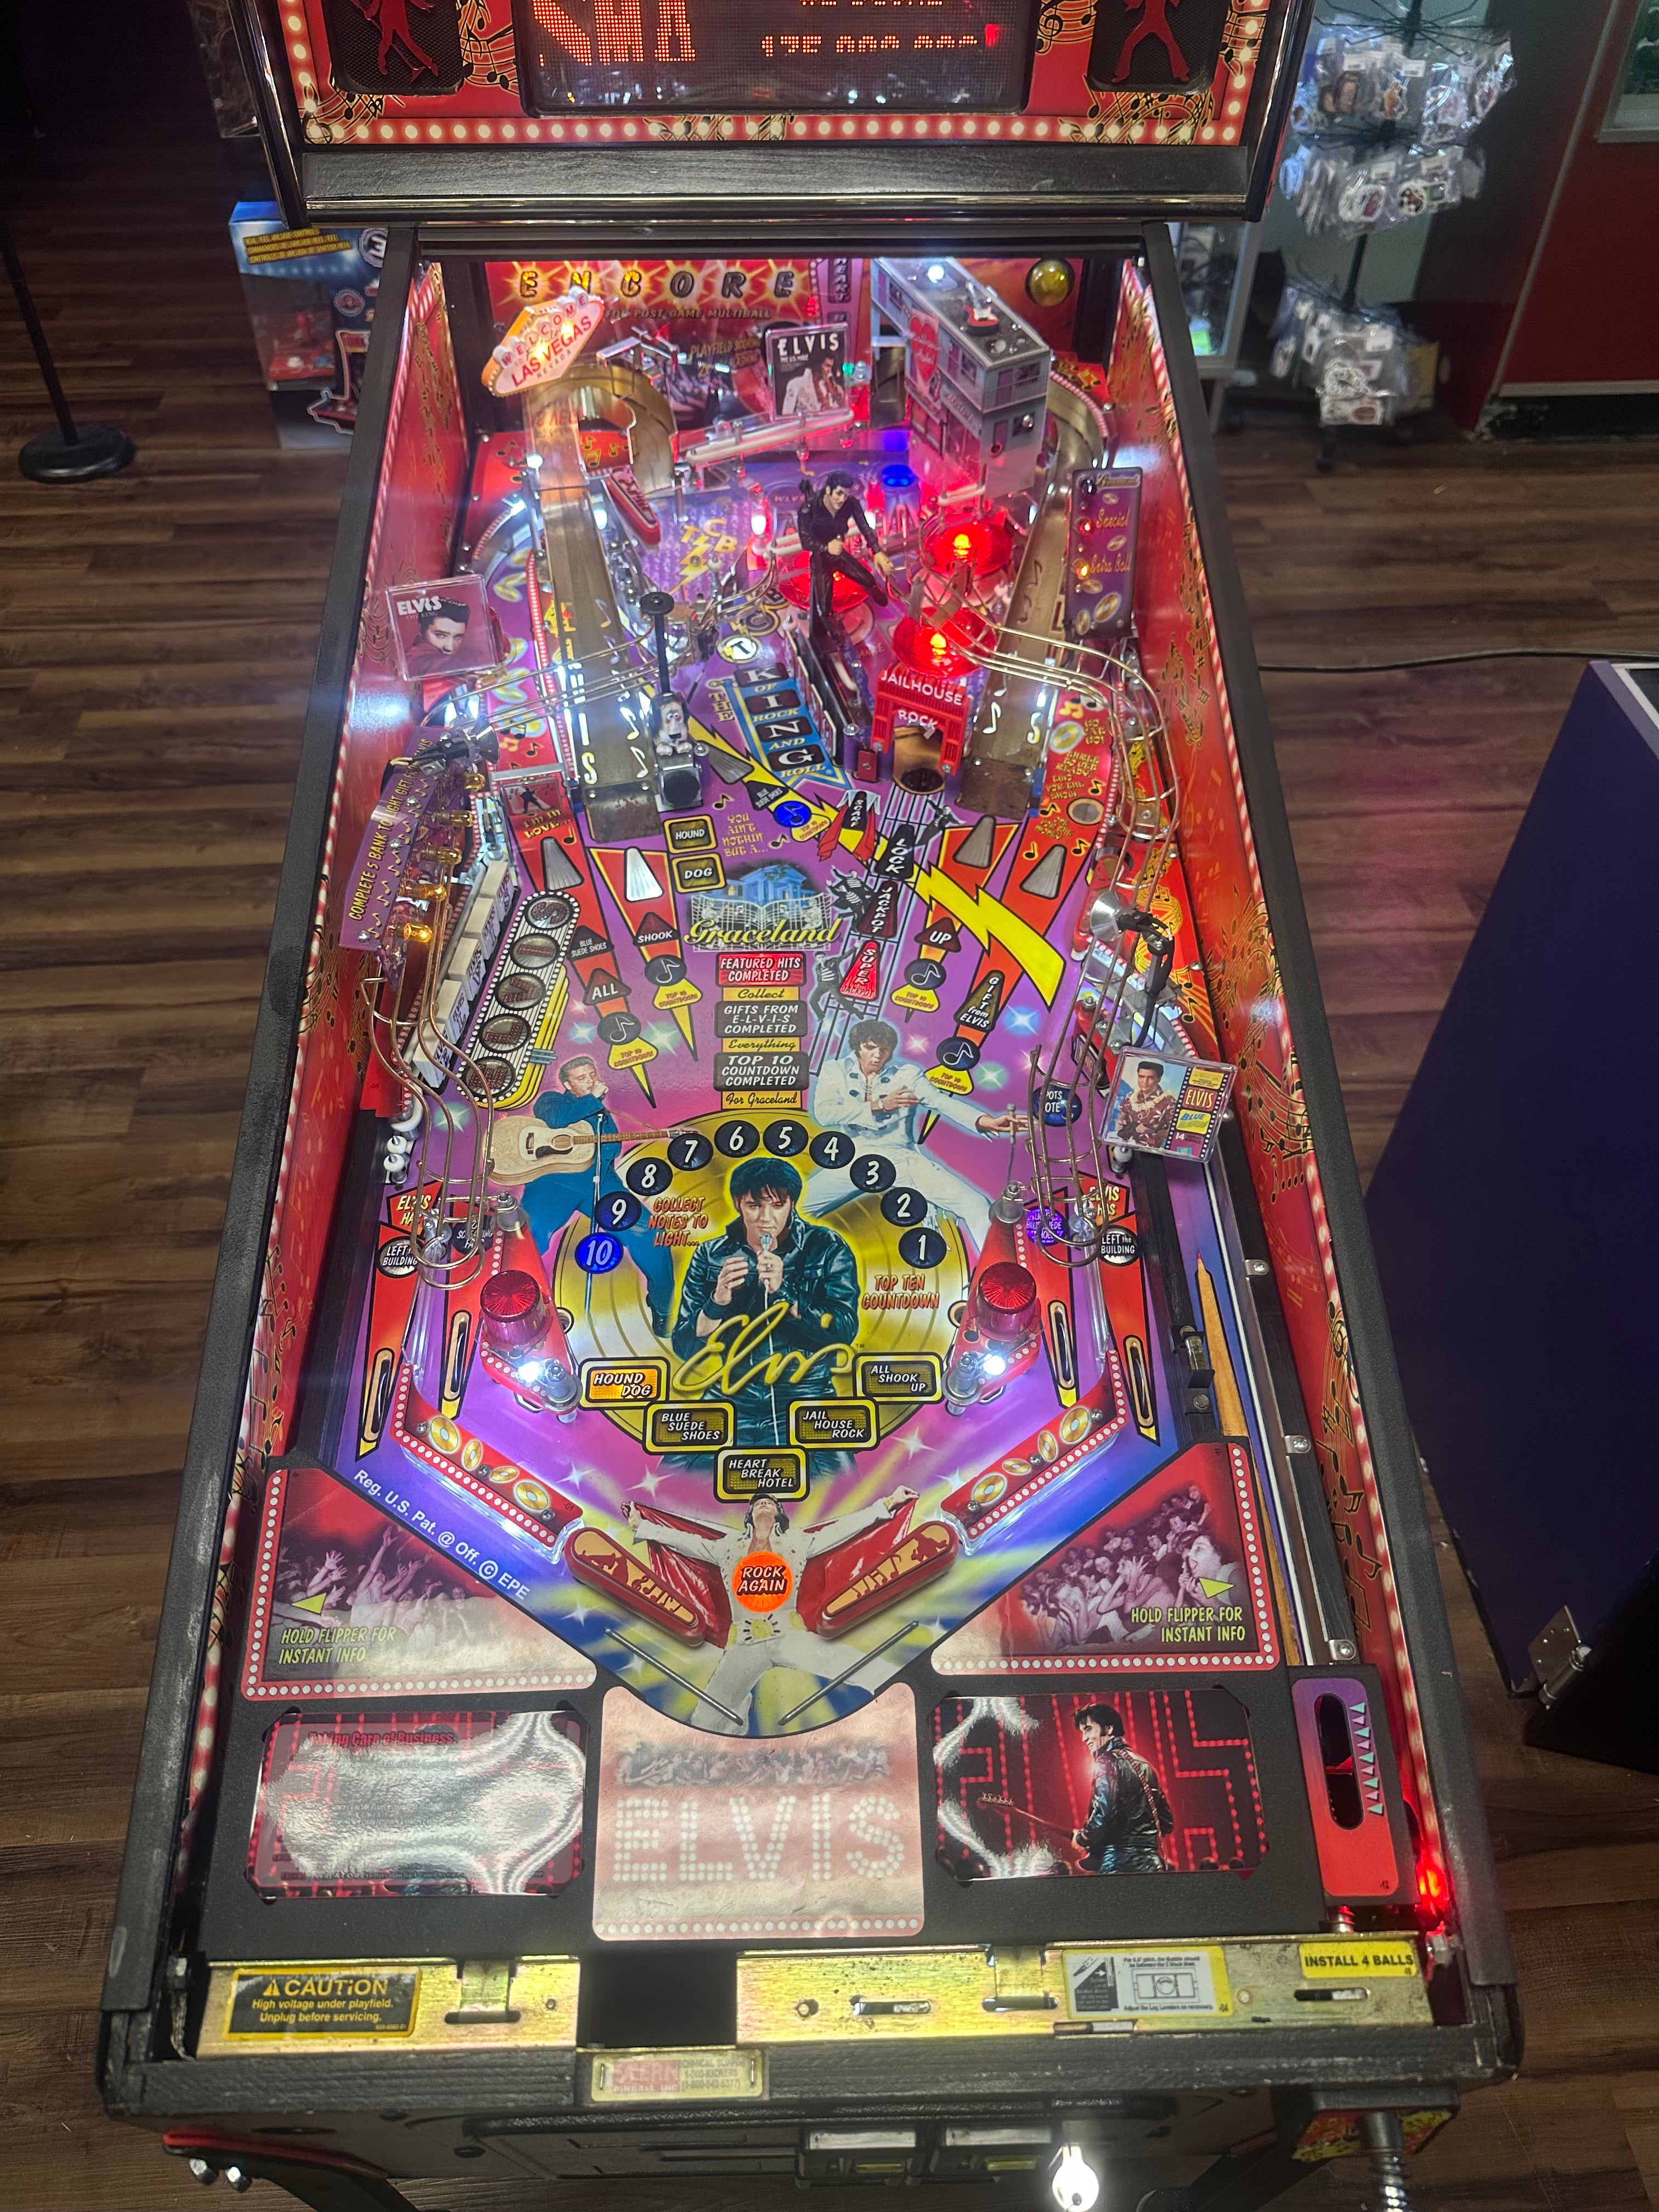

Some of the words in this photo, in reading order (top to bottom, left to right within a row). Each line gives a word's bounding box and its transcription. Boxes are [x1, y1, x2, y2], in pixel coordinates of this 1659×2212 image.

[634, 308, 663, 319] POST
[669, 309, 703, 319] GAME
[707, 309, 771, 319] MULTIBALL
[511, 361, 541, 387] LAS
[543, 315, 591, 363] VEGAS
[777, 332, 839, 357] ELVIS
[537, 351, 572, 379] NEVADA
[1113, 551, 1132, 573] Ball
[397, 595, 443, 617] ELVIS
[755, 684, 776, 693] OF
[880, 672, 962, 706] JAILHOUSE
[708, 692, 735, 722] THE
[753, 708, 800, 722] ROCK
[898, 710, 938, 730] ROCK
[769, 738, 805, 751] AND
[781, 763, 826, 778] ROLL
[397, 774, 414, 797] GIFT
[385, 792, 403, 821] LIGHT
[849, 799, 865, 828] SCARF
[727, 813, 750, 823] YOU
[377, 817, 394, 836] TO
[675, 828, 706, 839] HOUND
[368, 833, 388, 861] BANK
[722, 832, 764, 847] NOTHIN
[724, 846, 747, 857] BUT
[885, 837, 907, 874] LOCK
[370, 861, 379, 872] 5
[684, 868, 713, 880] DOG
[348, 870, 376, 922] COMPLETE
[870, 886, 894, 934] JACKPOT
[637, 929, 673, 944] SHOOK
[684, 918, 842, 946] Graceland
[929, 930, 952, 945] UP
[571, 947, 589, 957] SUEDE
[589, 942, 607, 953] SHOES
[580, 938, 593, 948] BLUE
[720, 957, 774, 970] FEATURED
[777, 957, 801, 969] HITS
[854, 947, 877, 986] SUPER
[727, 969, 789, 983] COMPLETED
[591, 983, 618, 1001] ALL
[665, 991, 678, 1000] TOP
[737, 989, 785, 999] Collect
[841, 986, 874, 997] JACKPOT
[905, 991, 918, 1000] TOP
[981, 977, 999, 1010] GIFT
[658, 993, 698, 1008] COUNTDOWN
[894, 994, 935, 1010] COUNTDOWN
[724, 1005, 758, 1015] GIFTS
[763, 1005, 799, 1014] FROM
[967, 1006, 989, 1018] from
[732, 1014, 791, 1024] E-L-V-I-S
[959, 1013, 990, 1029] ELVIS
[724, 1024, 797, 1034] COMPLETED
[728, 1039, 797, 1051] Everything
[613, 1050, 654, 1068] COUNTDOWN
[620, 1051, 634, 1059] TOP
[727, 1055, 764, 1065] TOP
[772, 1055, 794, 1065] 10
[721, 1065, 800, 1076] COUNTDOWN
[940, 1071, 953, 1081] TOP
[725, 1076, 797, 1087] COMPLETED
[929, 1076, 968, 1093] COUNTDOWN
[726, 1092, 745, 1105] For
[748, 1092, 798, 1108] Graceland
[1185, 1088, 1215, 1109] ELVIS
[1180, 1112, 1205, 1121] BLUE
[729, 1126, 744, 1150] 6
[778, 1126, 792, 1149] 5
[1175, 1132, 1185, 1141] 14
[685, 1139, 698, 1163] 7
[823, 1136, 839, 1161] 4
[641, 1164, 657, 1188] 8
[866, 1160, 879, 1185] 3
[612, 1199, 627, 1224] 9
[653, 1196, 706, 1212] COLLECT
[896, 1193, 911, 1217] 2
[647, 1214, 691, 1229] NOTES
[693, 1214, 709, 1229] TO
[653, 1230, 699, 1246] LIGHT...
[1102, 1234, 1120, 1244] LEFT
[1122, 1234, 1132, 1243] the
[386, 1245, 408, 1256] LEFT
[586, 1240, 613, 1265] 10
[918, 1234, 926, 1260] 1
[1101, 1245, 1135, 1254] BUILDING
[382, 1256, 417, 1266] BUILDING
[874, 1274, 898, 1291] TOP
[902, 1274, 926, 1290] TEN
[861, 1292, 940, 1310] COUNTDOWN
[673, 1301, 856, 1395] Elvis
[871, 1365, 890, 1374] ALL
[593, 1373, 645, 1386] HOUND
[878, 1373, 918, 1383] SHOOK
[621, 1384, 651, 1397] DOG
[911, 1383, 926, 1392] UP
[661, 1412, 691, 1423] BLUE
[803, 1410, 827, 1421] JAIL
[667, 1421, 705, 1432] SUEDE
[814, 1420, 853, 1430] HOUSE
[681, 1430, 720, 1441] SHOES
[832, 1429, 865, 1438] ROCK
[729, 1458, 768, 1469] HEART
[741, 1468, 781, 1479] BREAK
[757, 1477, 794, 1488] HOTEL
[354, 1469, 381, 1497] Reg.
[384, 1489, 409, 1517] U.S.
[411, 1511, 435, 1536] Pat.
[455, 1542, 478, 1565] Off.
[497, 1572, 531, 1601] EPE
[742, 1566, 786, 1579] ROCK
[737, 1579, 787, 1594] AGAIN
[1131, 1607, 1162, 1623] HOLD
[1166, 1606, 1215, 1623] FLIPPER
[1218, 1606, 1243, 1622] FOR
[281, 1628, 316, 1644] HOLD
[318, 1626, 367, 1644] FLIPPER
[371, 1626, 396, 1642] FOR
[1161, 1626, 1212, 1643] INSTANT
[1216, 1625, 1246, 1641] INFO
[278, 1647, 334, 1664] INSTANT
[336, 1646, 366, 1663] INFO
[351, 1731, 380, 1746] Care
[383, 1732, 396, 1745] of
[397, 1732, 454, 1745] Business
[612, 1793, 905, 1881] ELVIS
[1304, 1954, 1358, 1966] INSTALL
[1361, 1954, 1370, 1966] 4
[1372, 1954, 1414, 1965] BALLS
[284, 1978, 389, 1997] CAUTION
[252, 1998, 275, 2010] High
[278, 1998, 314, 2010] voltage
[317, 1999, 346, 2009] under
[348, 1997, 394, 2011] playfield.
[259, 2012, 296, 2024] Unplug
[298, 2012, 330, 2022] before
[333, 2012, 382, 2024] servicing.
